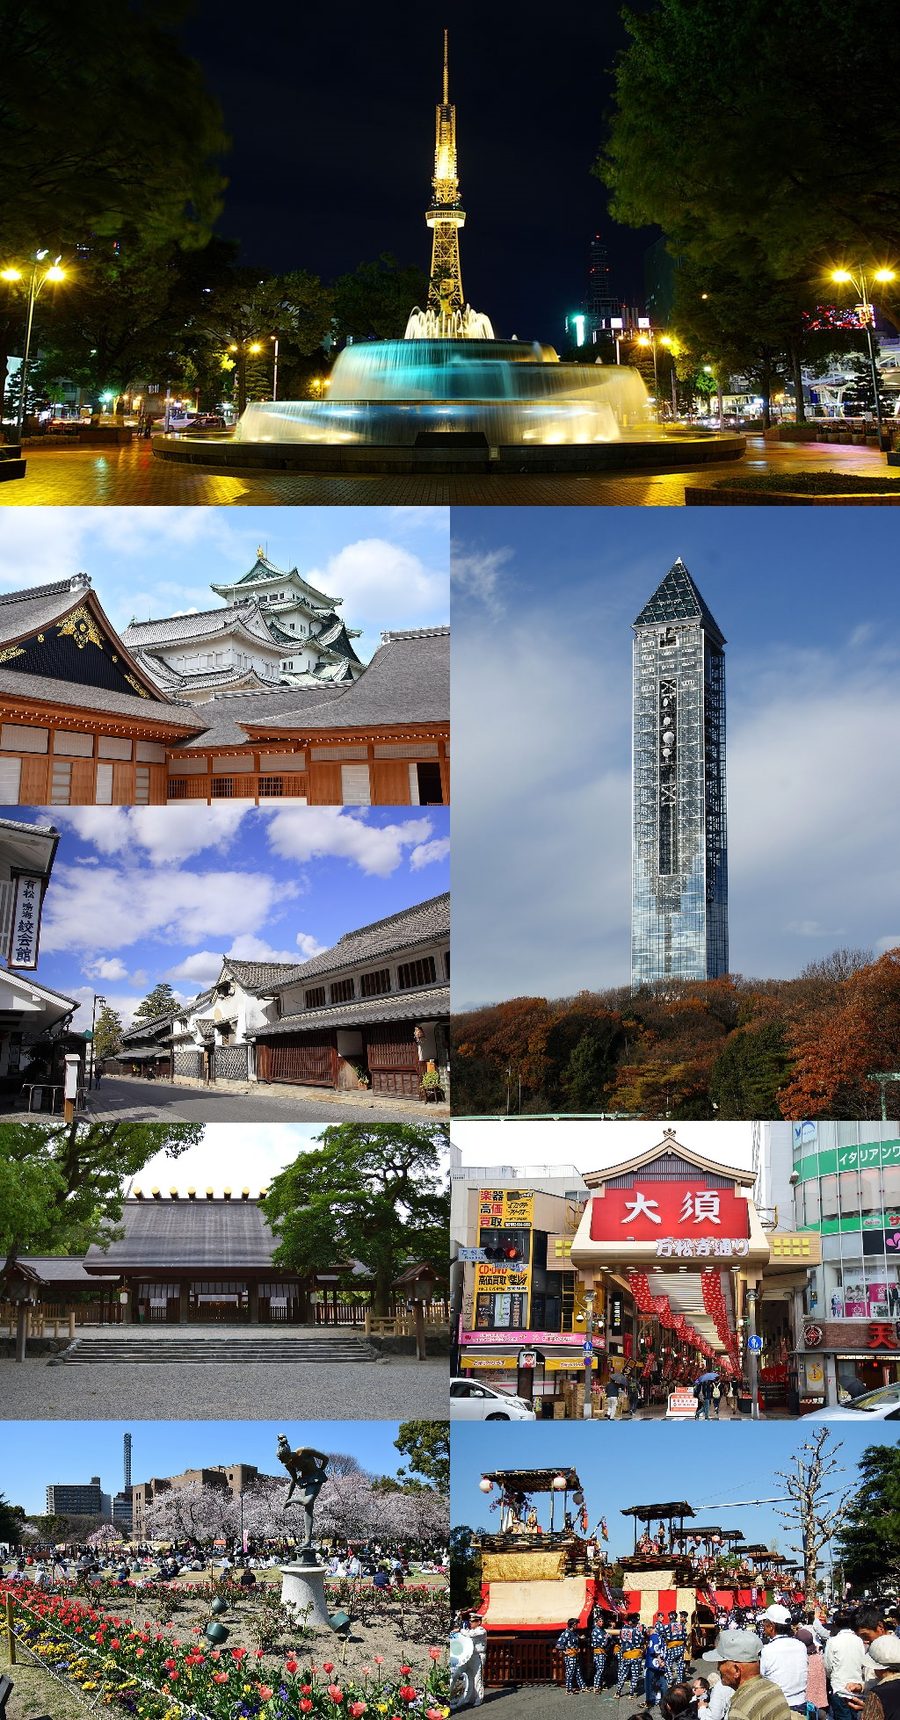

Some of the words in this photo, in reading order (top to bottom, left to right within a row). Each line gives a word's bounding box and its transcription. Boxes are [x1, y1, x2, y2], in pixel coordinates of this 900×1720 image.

[481, 1190, 504, 1201] 楽器
[480, 1203, 503, 1214] 高価
[621, 1190, 721, 1224] 大須
[480, 1217, 502, 1226] 買取
[867, 1322, 897, 1349] 天
